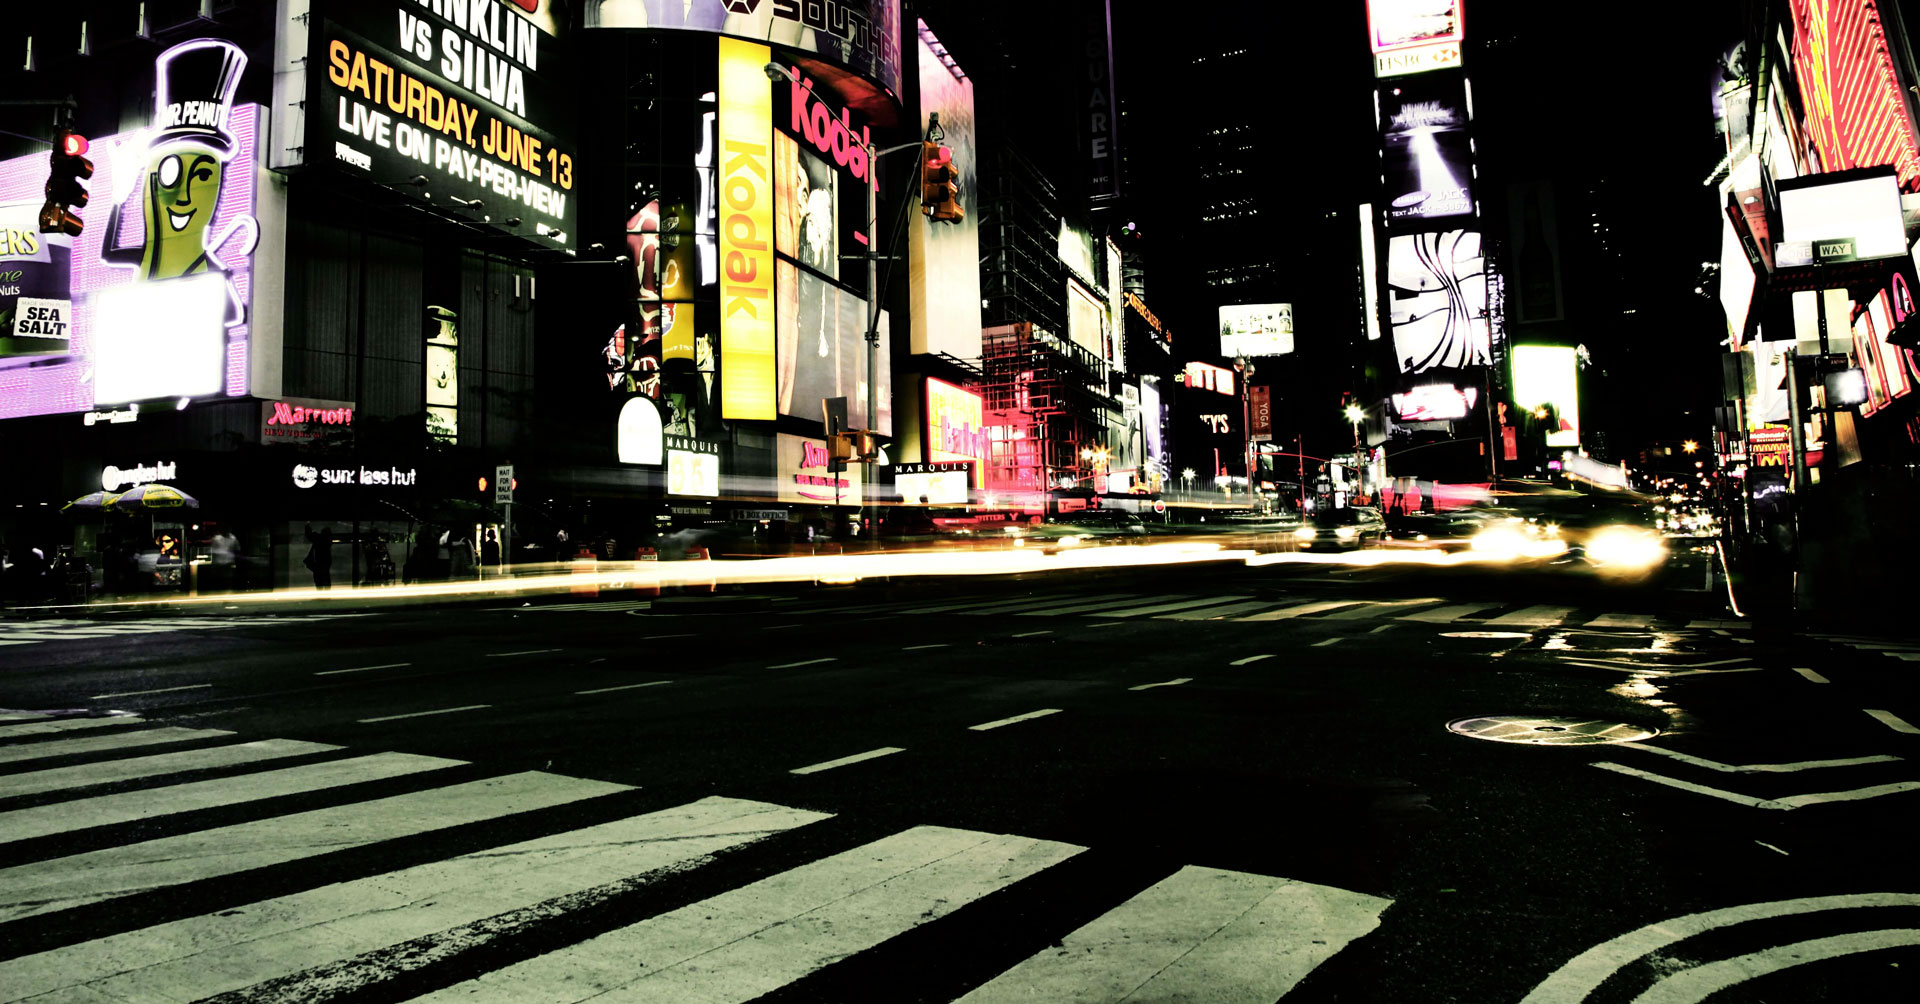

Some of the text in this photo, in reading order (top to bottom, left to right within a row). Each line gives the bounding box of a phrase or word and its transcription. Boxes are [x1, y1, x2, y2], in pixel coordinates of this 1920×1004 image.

[398, 8, 526, 118] VS SILVA
[328, 39, 573, 190] SATURDAY, JUNE 13
[338, 95, 566, 220] LIVE ON PAY-PER-VIEW
[1093, 175, 1109, 184] NYC
[1407, 206, 1432, 216] JACK
[724, 138, 769, 321] Kodak
[1822, 245, 1846, 256] WAY
[27, 306, 60, 321] SEA
[18, 319, 67, 335] SALT
[1259, 402, 1269, 428] YOGA
[667, 437, 719, 453] MARQUIS
[157, 460, 176, 480] hut
[391, 466, 416, 485] hut
[895, 462, 968, 473] MARQUIS
